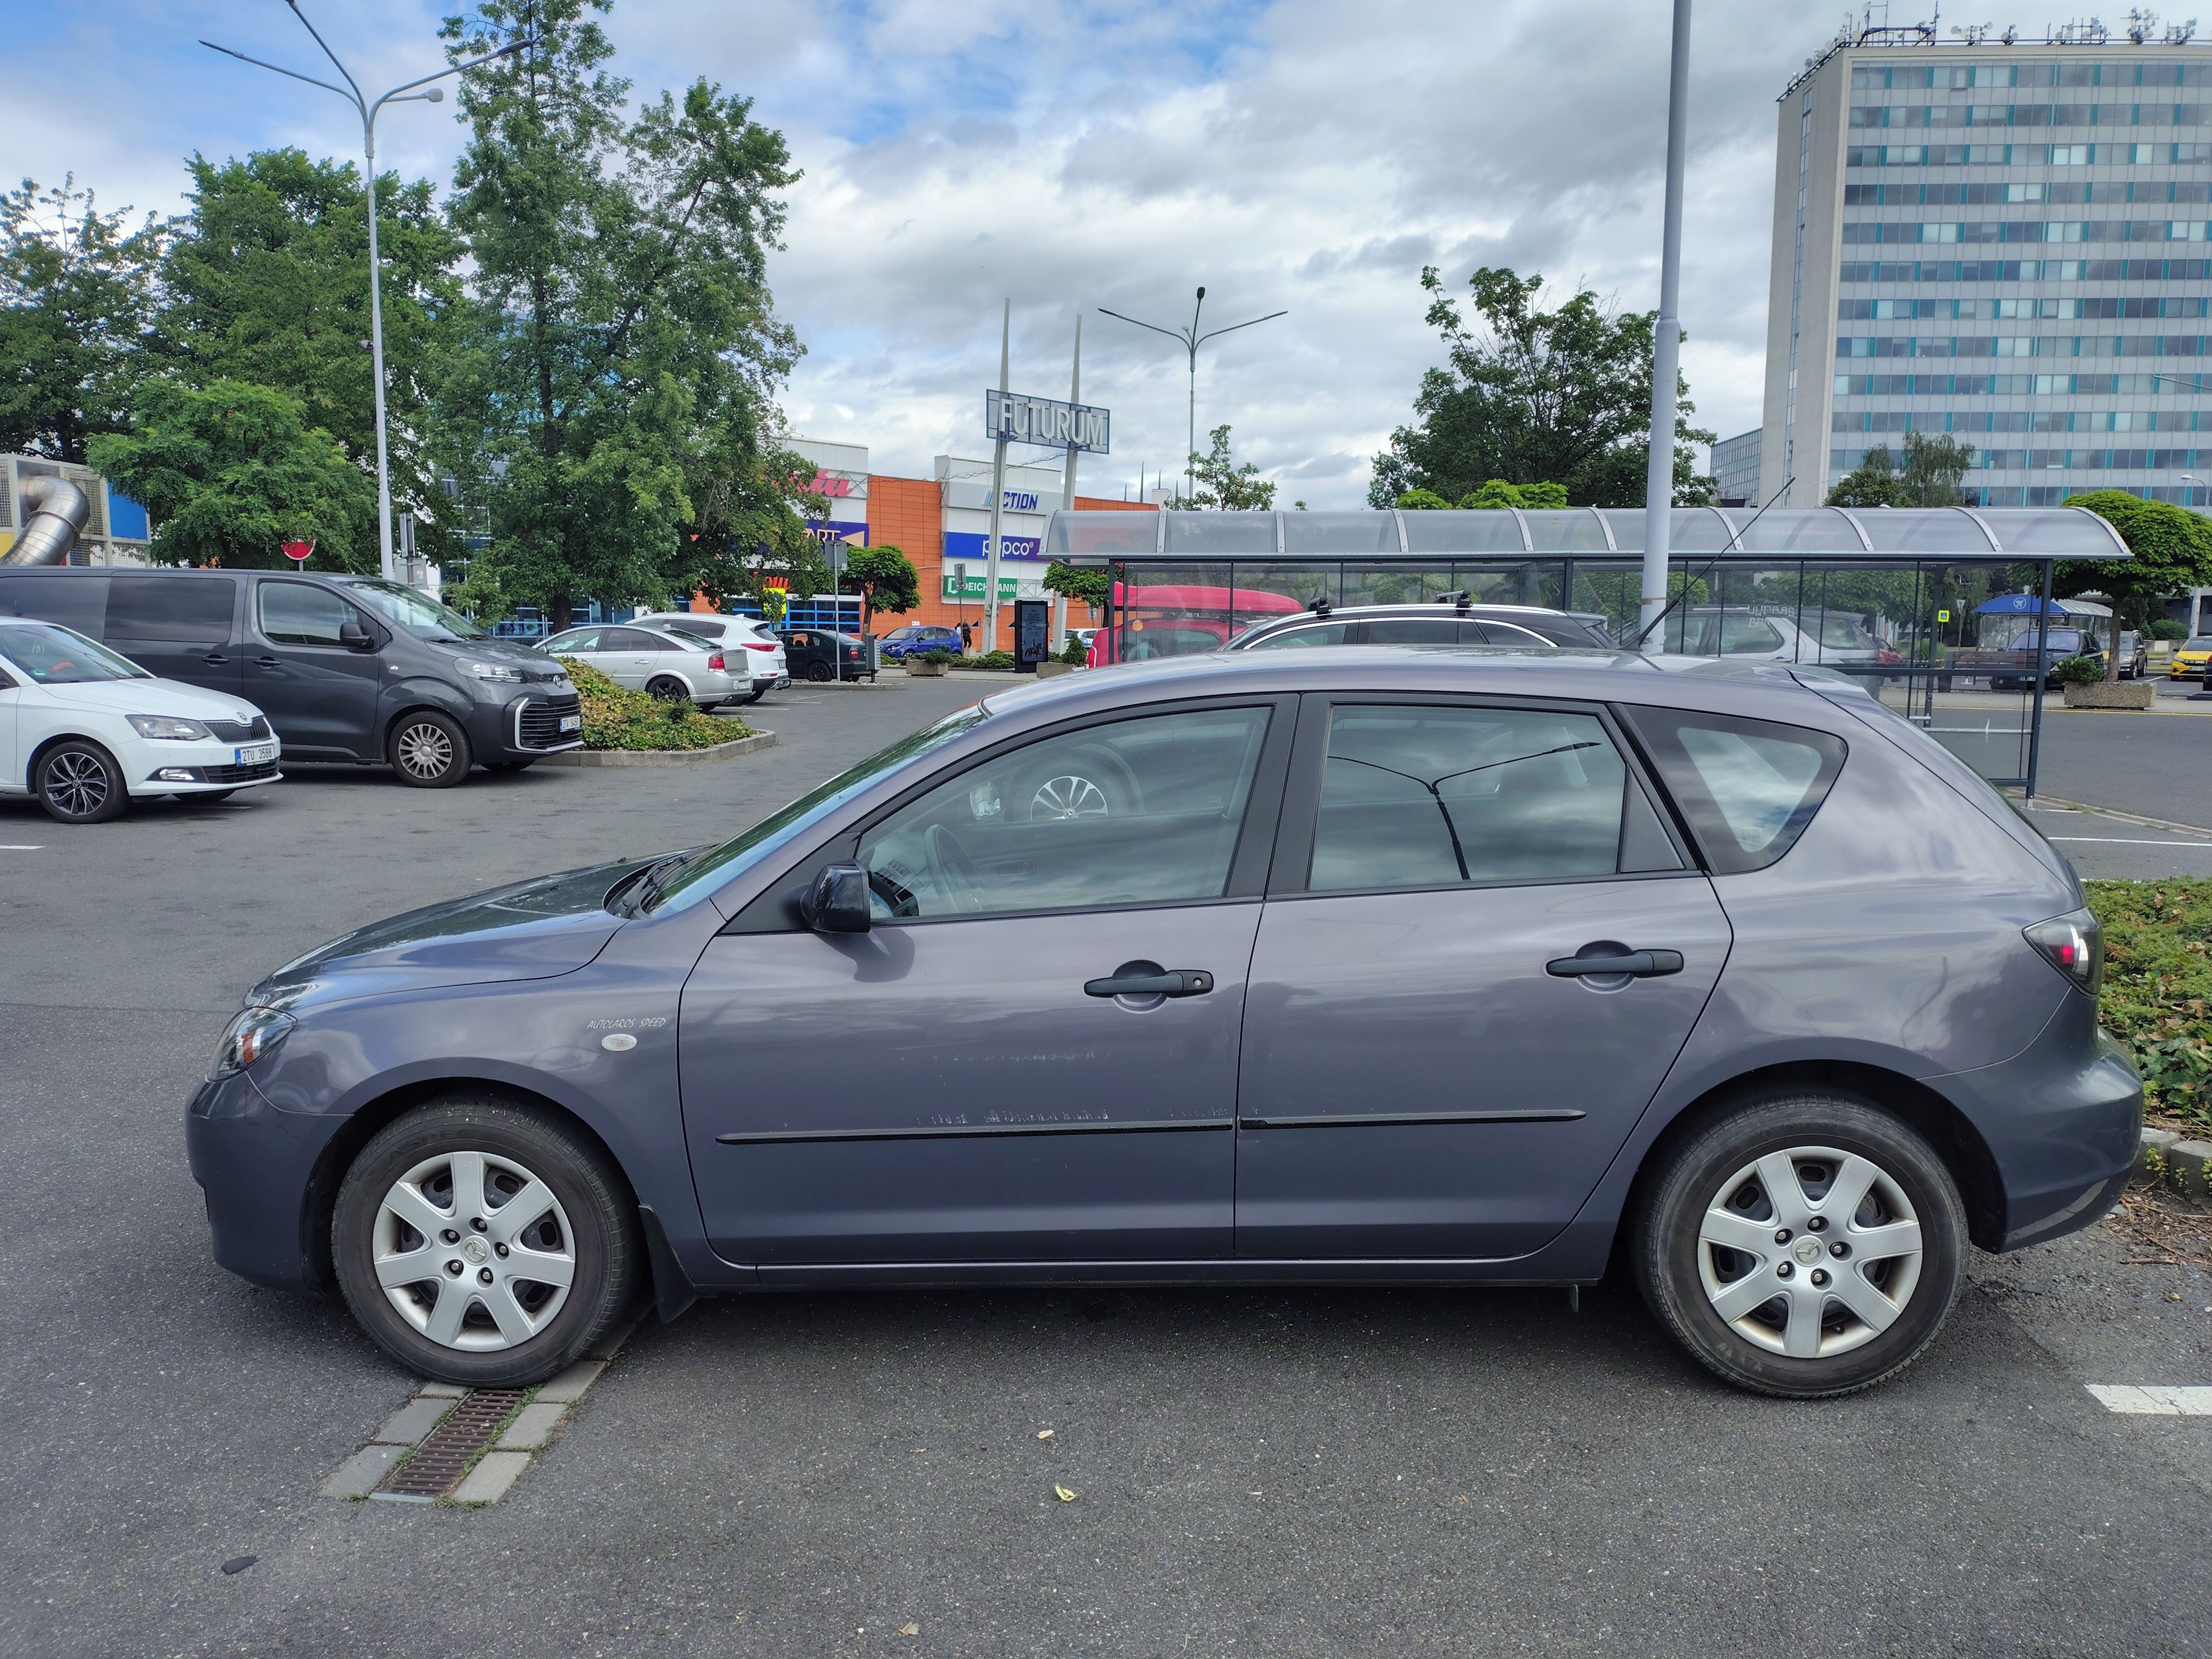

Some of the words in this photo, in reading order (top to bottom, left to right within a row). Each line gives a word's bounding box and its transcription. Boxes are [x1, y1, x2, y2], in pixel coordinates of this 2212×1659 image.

[1000, 397, 1103, 447] FUTURUM
[982, 539, 1030, 558] ppco
[1747, 604, 1795, 616] ULTRAS
[242, 750, 254, 761] 2TU
[258, 747, 272, 759] 3588
[639, 1017, 666, 1028] SPEED
